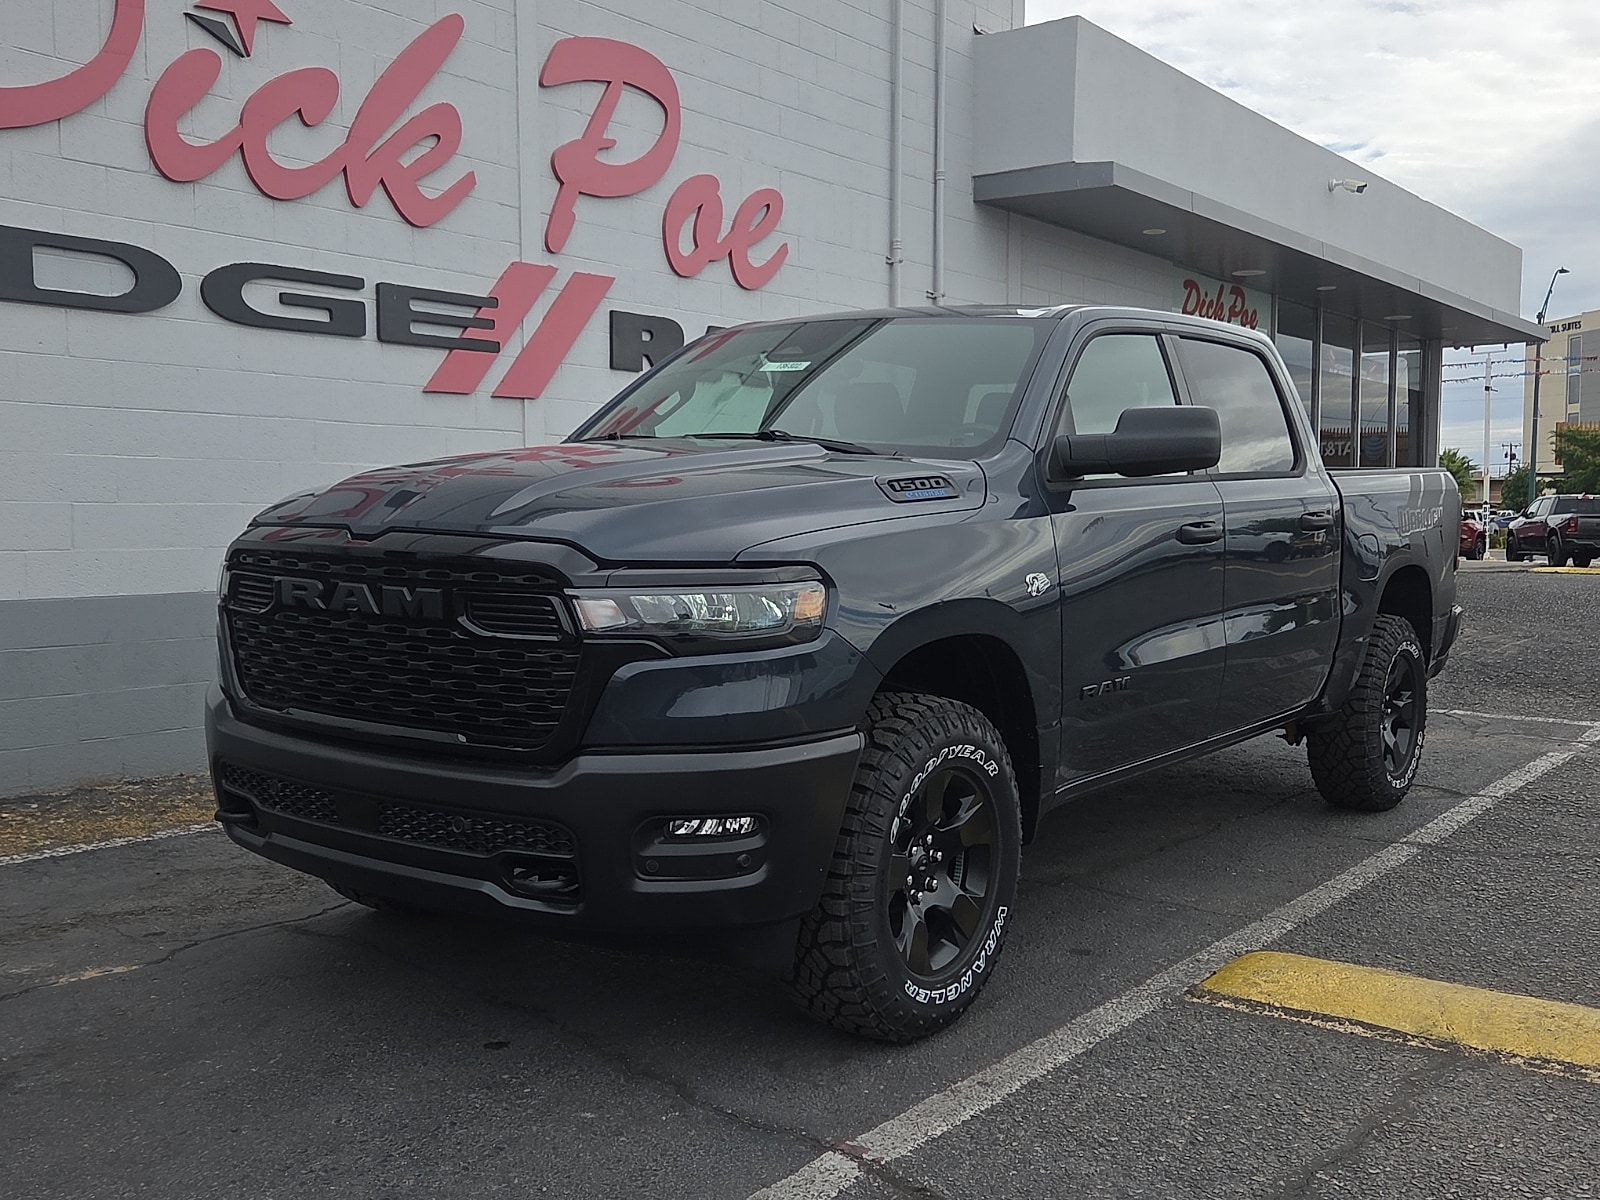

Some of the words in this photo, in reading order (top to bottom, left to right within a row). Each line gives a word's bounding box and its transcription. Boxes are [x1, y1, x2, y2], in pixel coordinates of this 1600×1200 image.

[539, 36, 788, 291] Poe
[1182, 279, 1225, 321] Dick
[1227, 285, 1258, 330] Poe
[888, 478, 946, 491] 1500
[275, 576, 443, 619] RAM
[890, 744, 999, 845] GOODYEAR
[904, 905, 1008, 1005] WRANGLER
